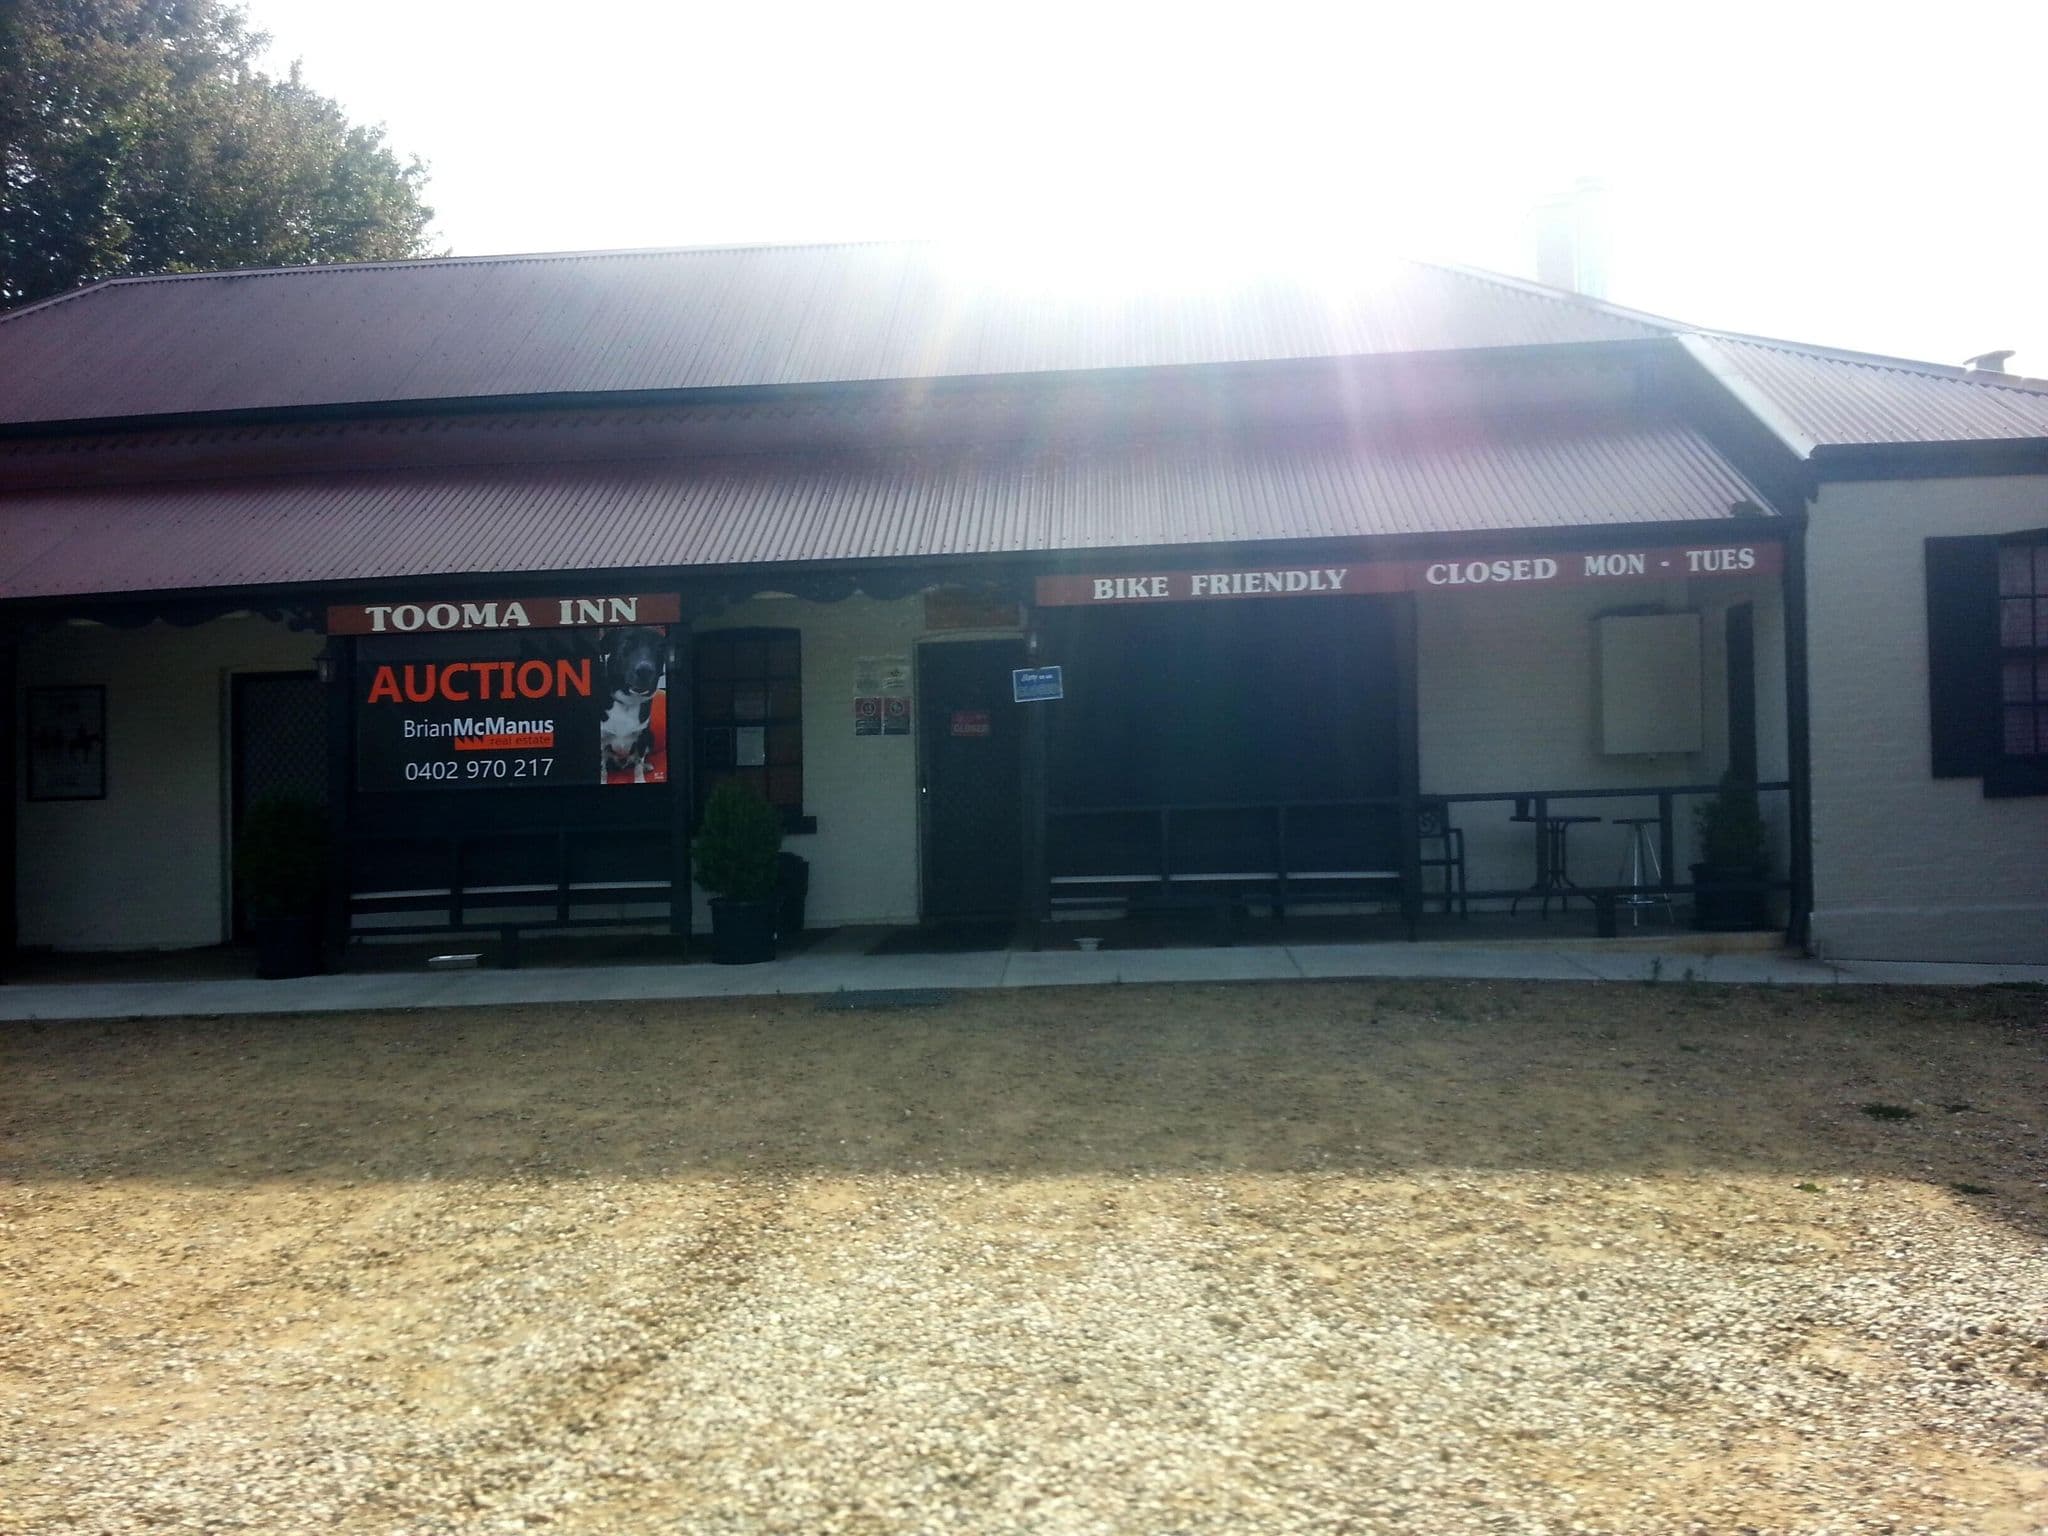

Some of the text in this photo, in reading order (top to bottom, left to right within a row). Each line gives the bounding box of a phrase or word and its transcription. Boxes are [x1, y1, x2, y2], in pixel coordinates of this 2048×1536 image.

[1426, 558, 1557, 585] CLOSED
[1584, 553, 1645, 577] MON
[1686, 548, 1756, 572] TUES
[1093, 569, 1347, 600] BIKE FRIENDLY
[365, 598, 638, 631] TOOMA INN
[367, 658, 592, 704] AUCTION
[405, 758, 554, 780] 0402 970 217
